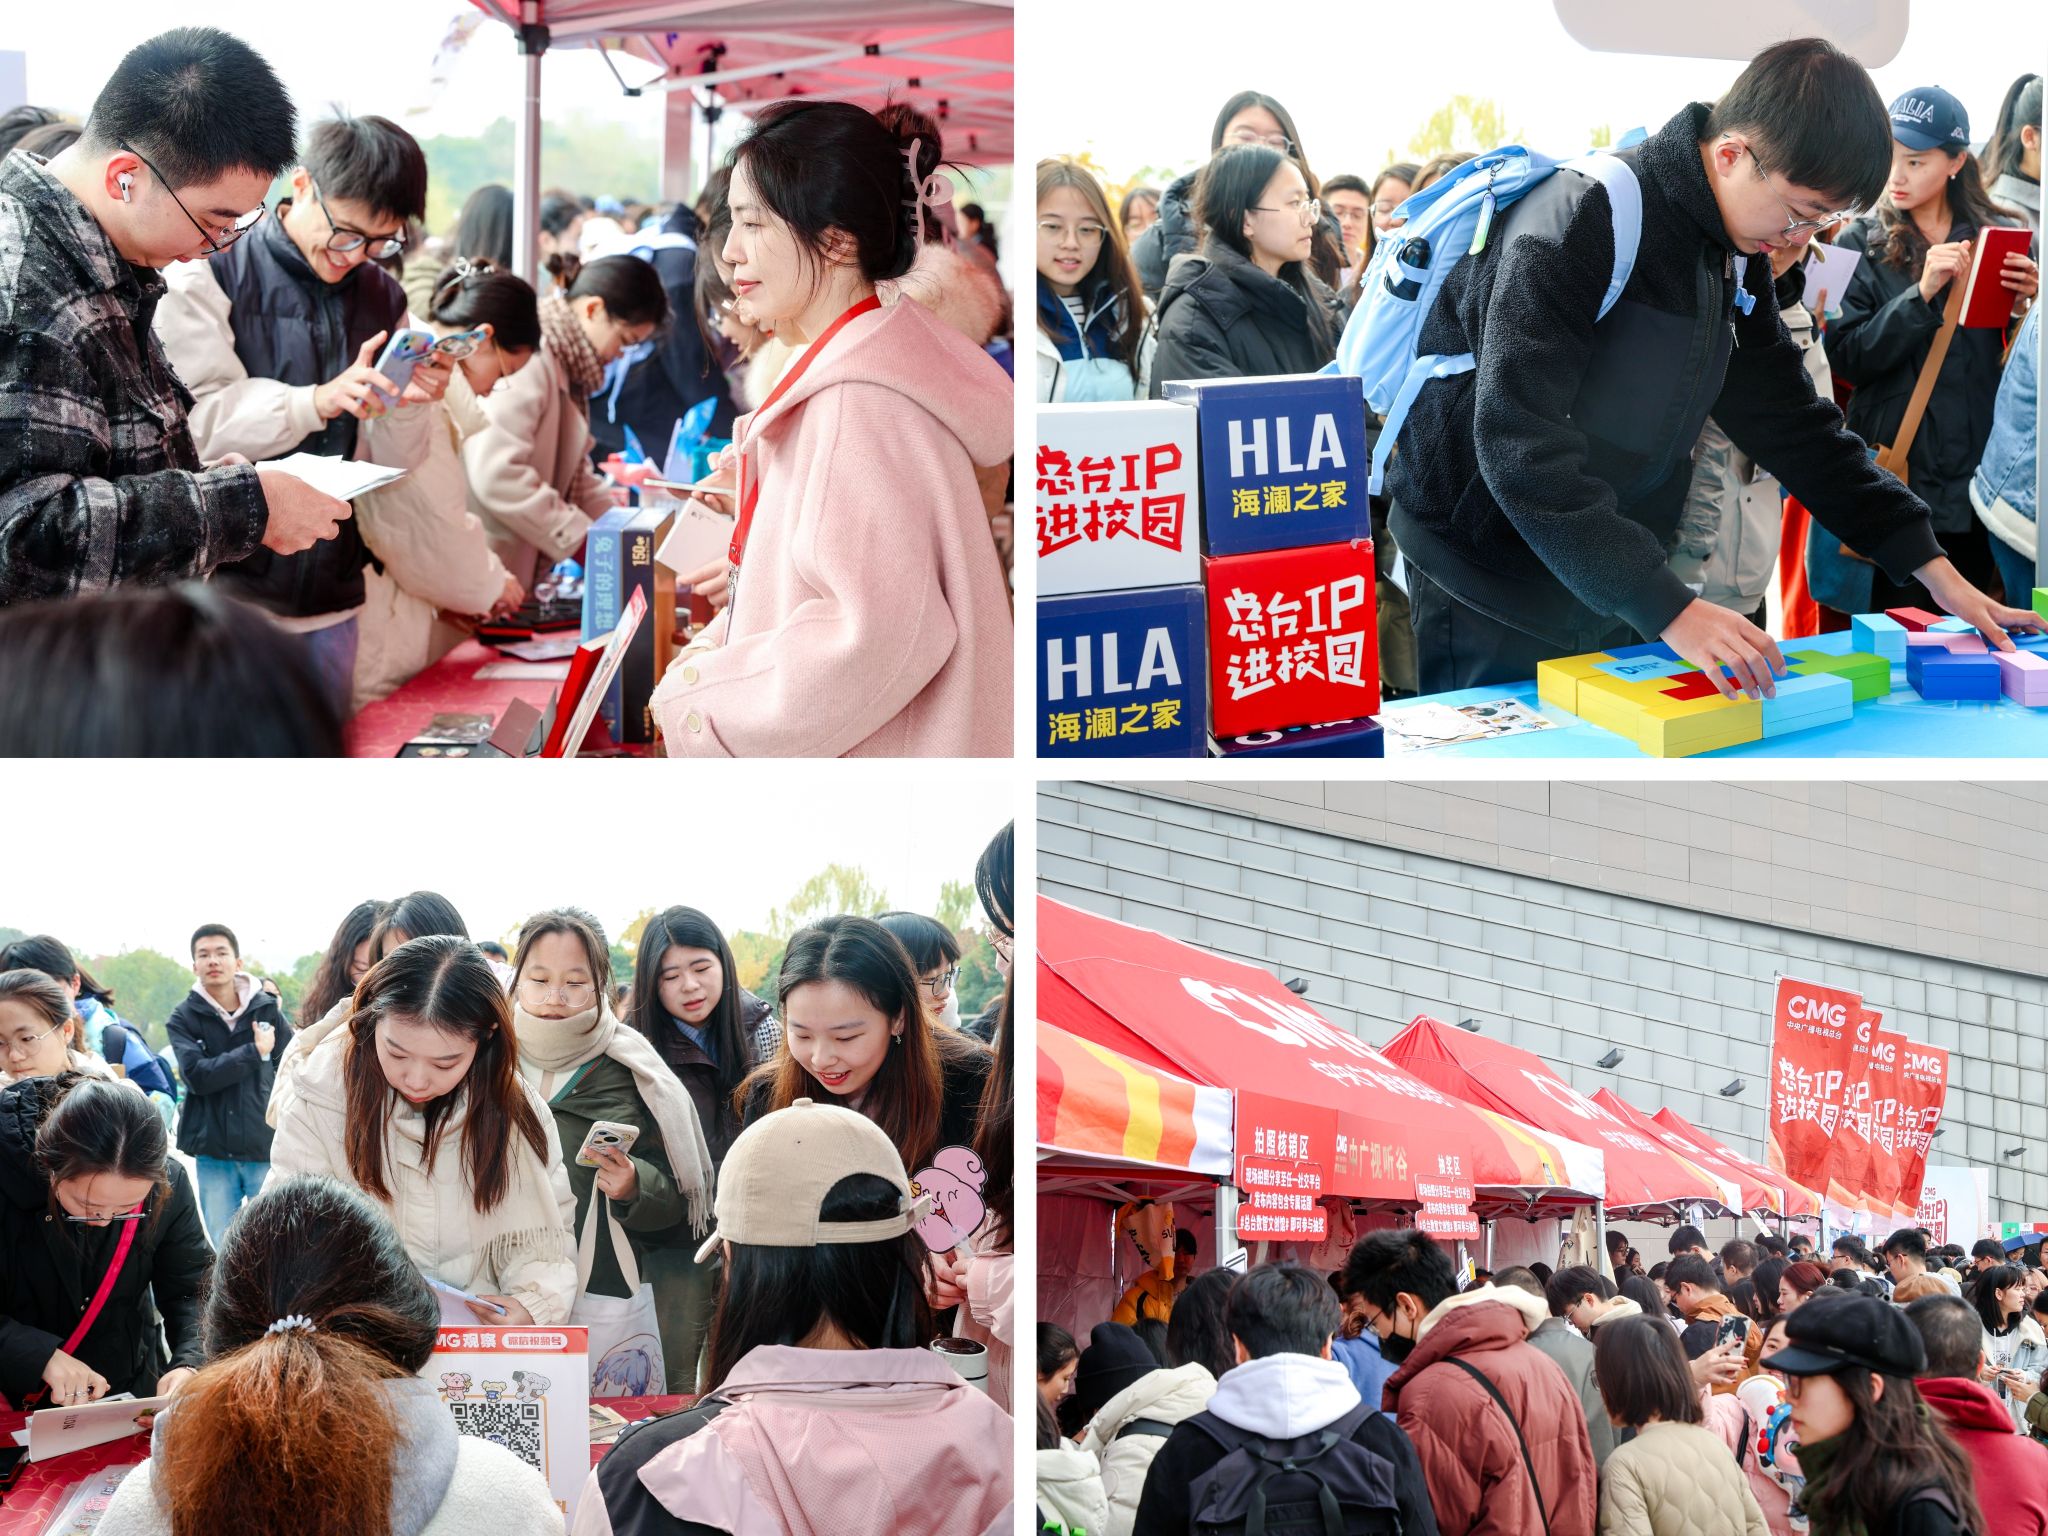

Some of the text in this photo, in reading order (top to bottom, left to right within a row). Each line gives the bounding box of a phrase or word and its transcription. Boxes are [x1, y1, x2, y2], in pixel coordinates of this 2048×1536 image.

[1228, 413, 1347, 478] HLA
[1036, 442, 1183, 496] 总台IP
[1232, 480, 1347, 518] 海澜之家
[1036, 493, 1186, 558] 进校园
[1223, 574, 1366, 642] 总台IP
[1047, 627, 1182, 701] HLA
[1226, 630, 1366, 701] 进校园
[1048, 698, 1182, 745] 海澜之家
[1788, 995, 1847, 1027] CMG
[1778, 1056, 1844, 1100] 总台IP
[1776, 1091, 1840, 1140] 进校园
[1254, 1126, 1309, 1160] 拍照核销区
[1349, 1137, 1409, 1182] 中广视听谷
[1245, 1167, 1321, 1190] 现场拍照分享至任一社交平台
[1254, 1191, 1313, 1211] 发布内容包含专属话题
[463, 1333, 496, 1348] 观察
[508, 1336, 561, 1346] 微信视频号
